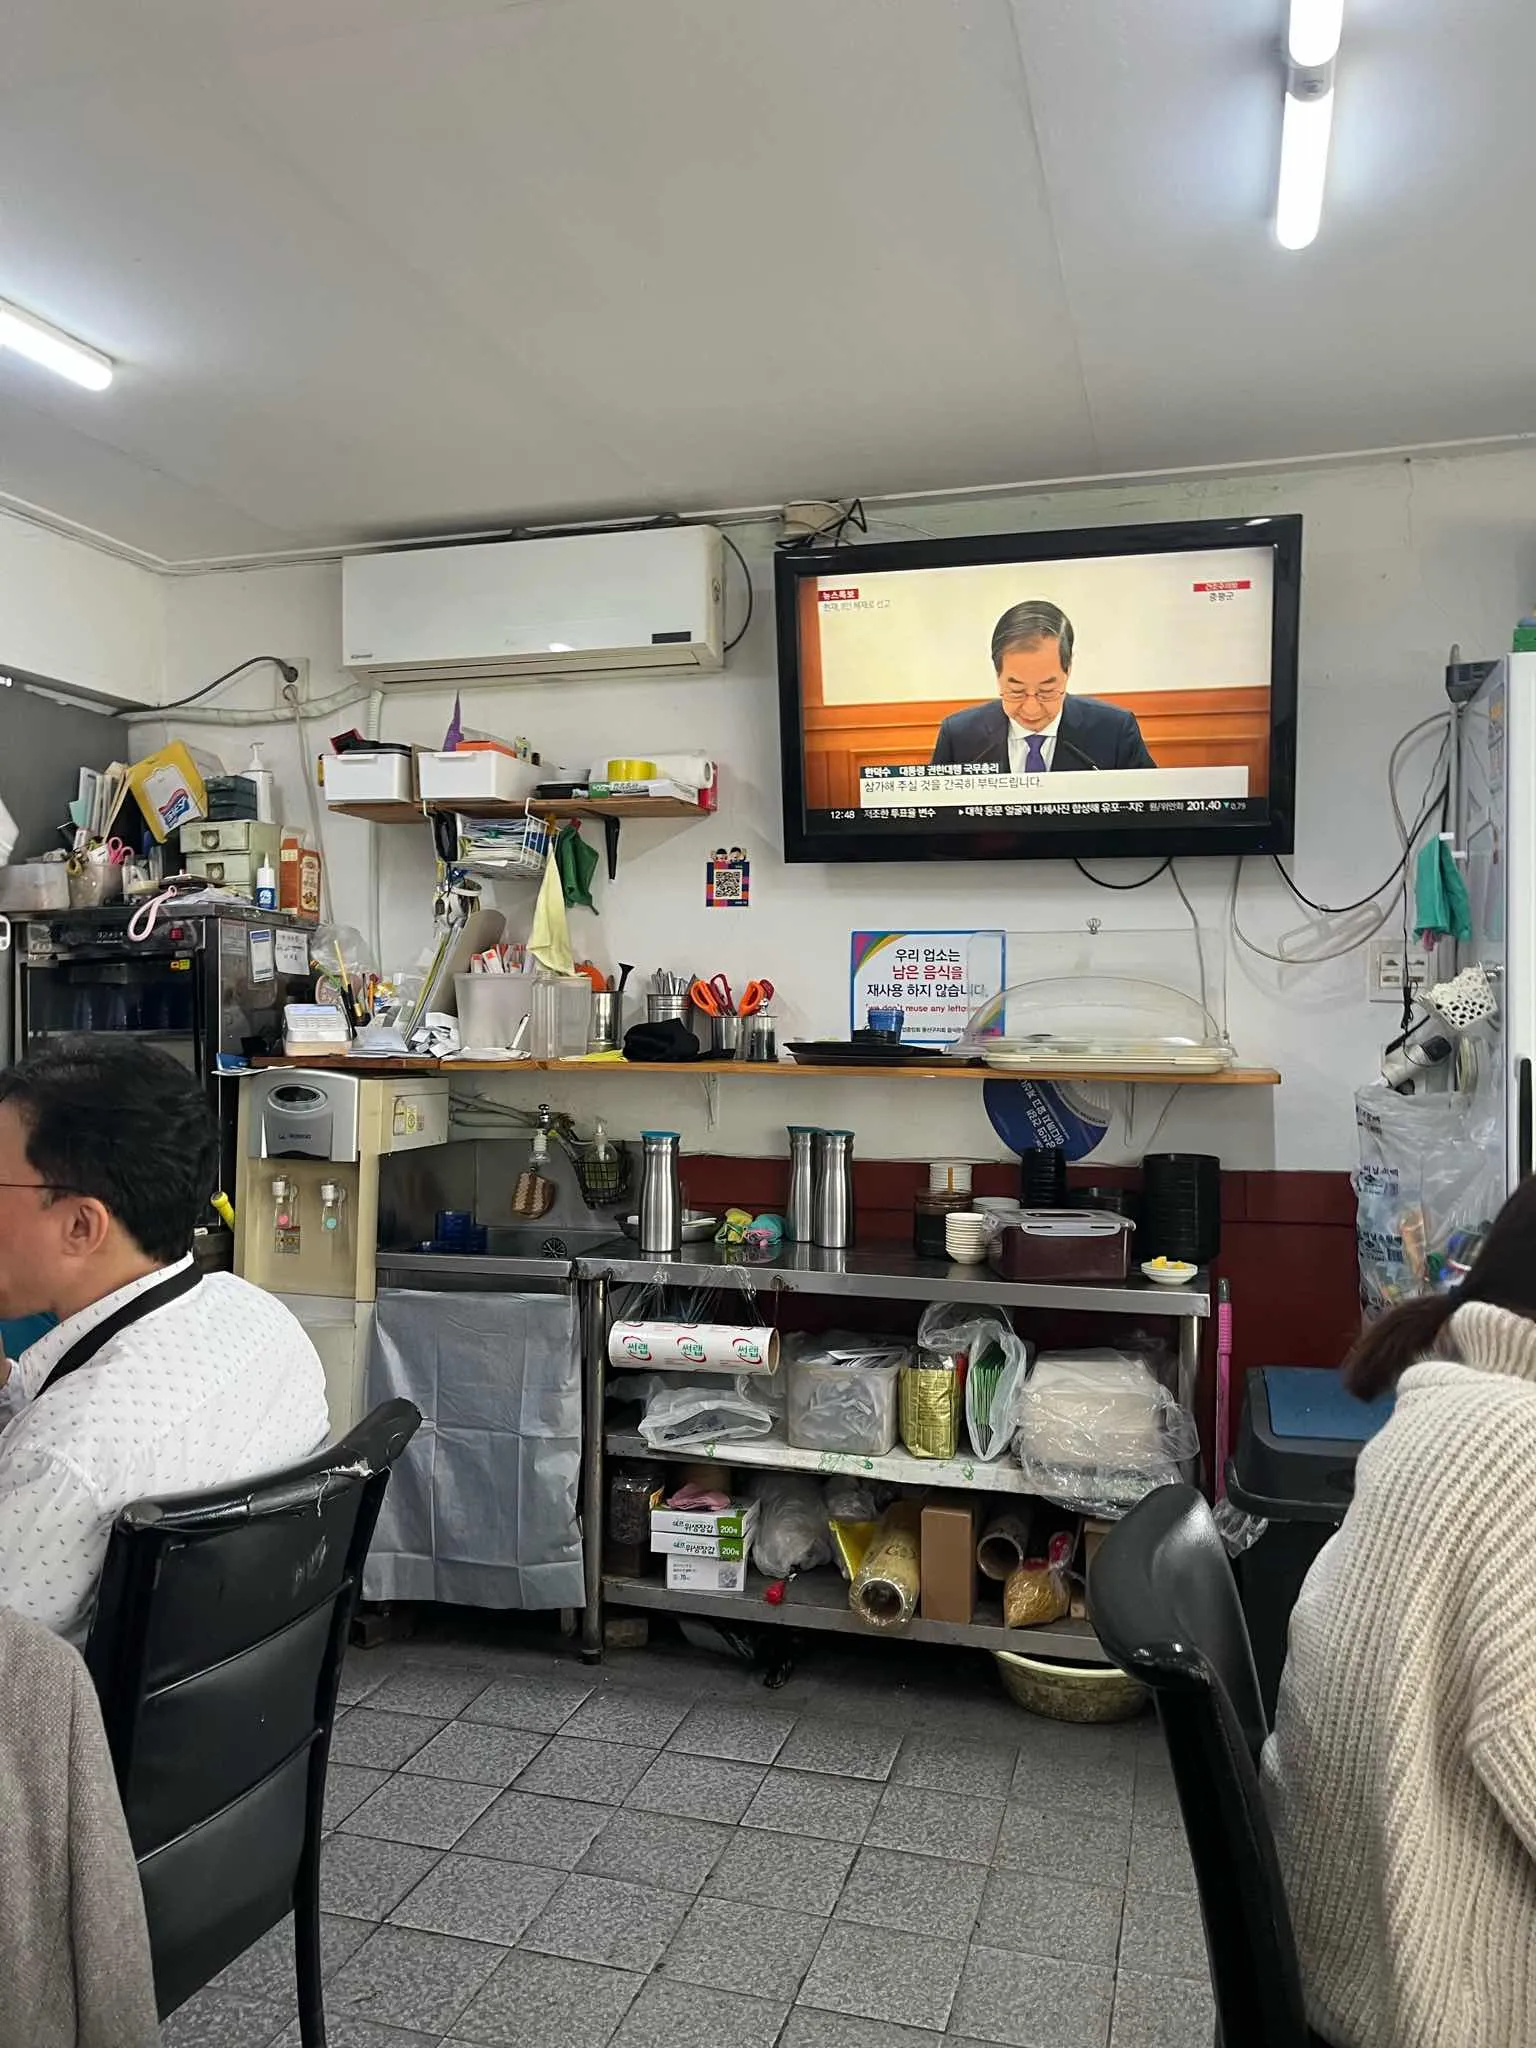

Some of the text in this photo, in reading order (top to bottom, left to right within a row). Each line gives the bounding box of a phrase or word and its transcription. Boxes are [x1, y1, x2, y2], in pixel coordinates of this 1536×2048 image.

[822, 590, 856, 600] 뉴스특보
[864, 763, 1000, 778] 한덕수 대통령 권한대행 국무총리
[864, 776, 1045, 793] 삼가해 주실 것을 간곡히 부탁드립니다.
[964, 806, 983, 816] 대학
[984, 805, 1003, 816] 동문
[1004, 804, 1032, 816] 얼굴에
[1033, 803, 1070, 814] 나체사진
[1071, 803, 1100, 814] 합성해
[1186, 800, 1222, 811] 201.40
[830, 810, 856, 820] 12:48
[863, 807, 936, 819] 저조한 투표율 변수
[895, 948, 961, 963] 우리 업소는
[892, 965, 963, 980] 남은 음식을
[866, 983, 989, 998] 재사용 하지 않습니다.
[905, 1005, 928, 1013] reuse
[930, 1005, 945, 1013] any
[1031, 1098, 1047, 1115] 알고
[1042, 1113, 1065, 1145] 어디까지
[684, 1522, 714, 1533] 위생장갑
[686, 1544, 715, 1555] 위생장갑
